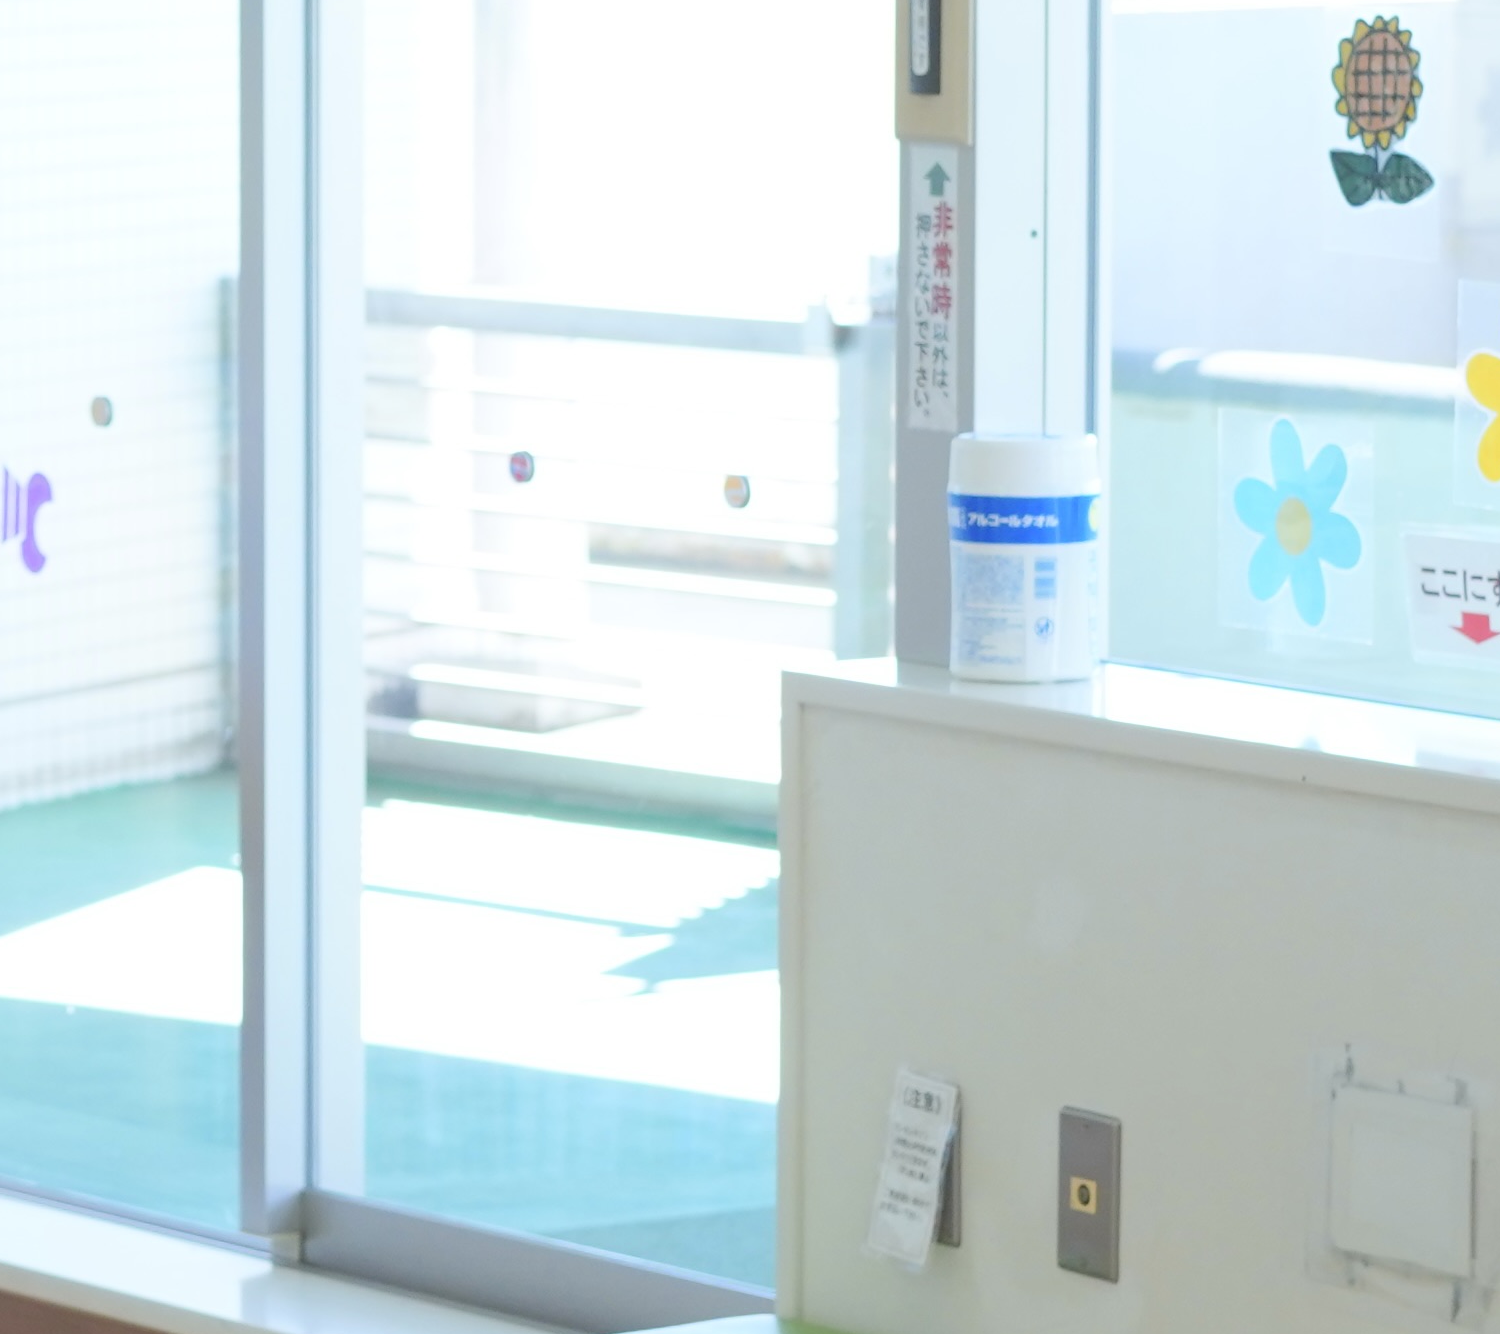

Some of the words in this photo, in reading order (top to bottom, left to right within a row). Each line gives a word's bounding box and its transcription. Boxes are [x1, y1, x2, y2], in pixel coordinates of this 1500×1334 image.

[967, 511, 1060, 529] アルコールタオル
